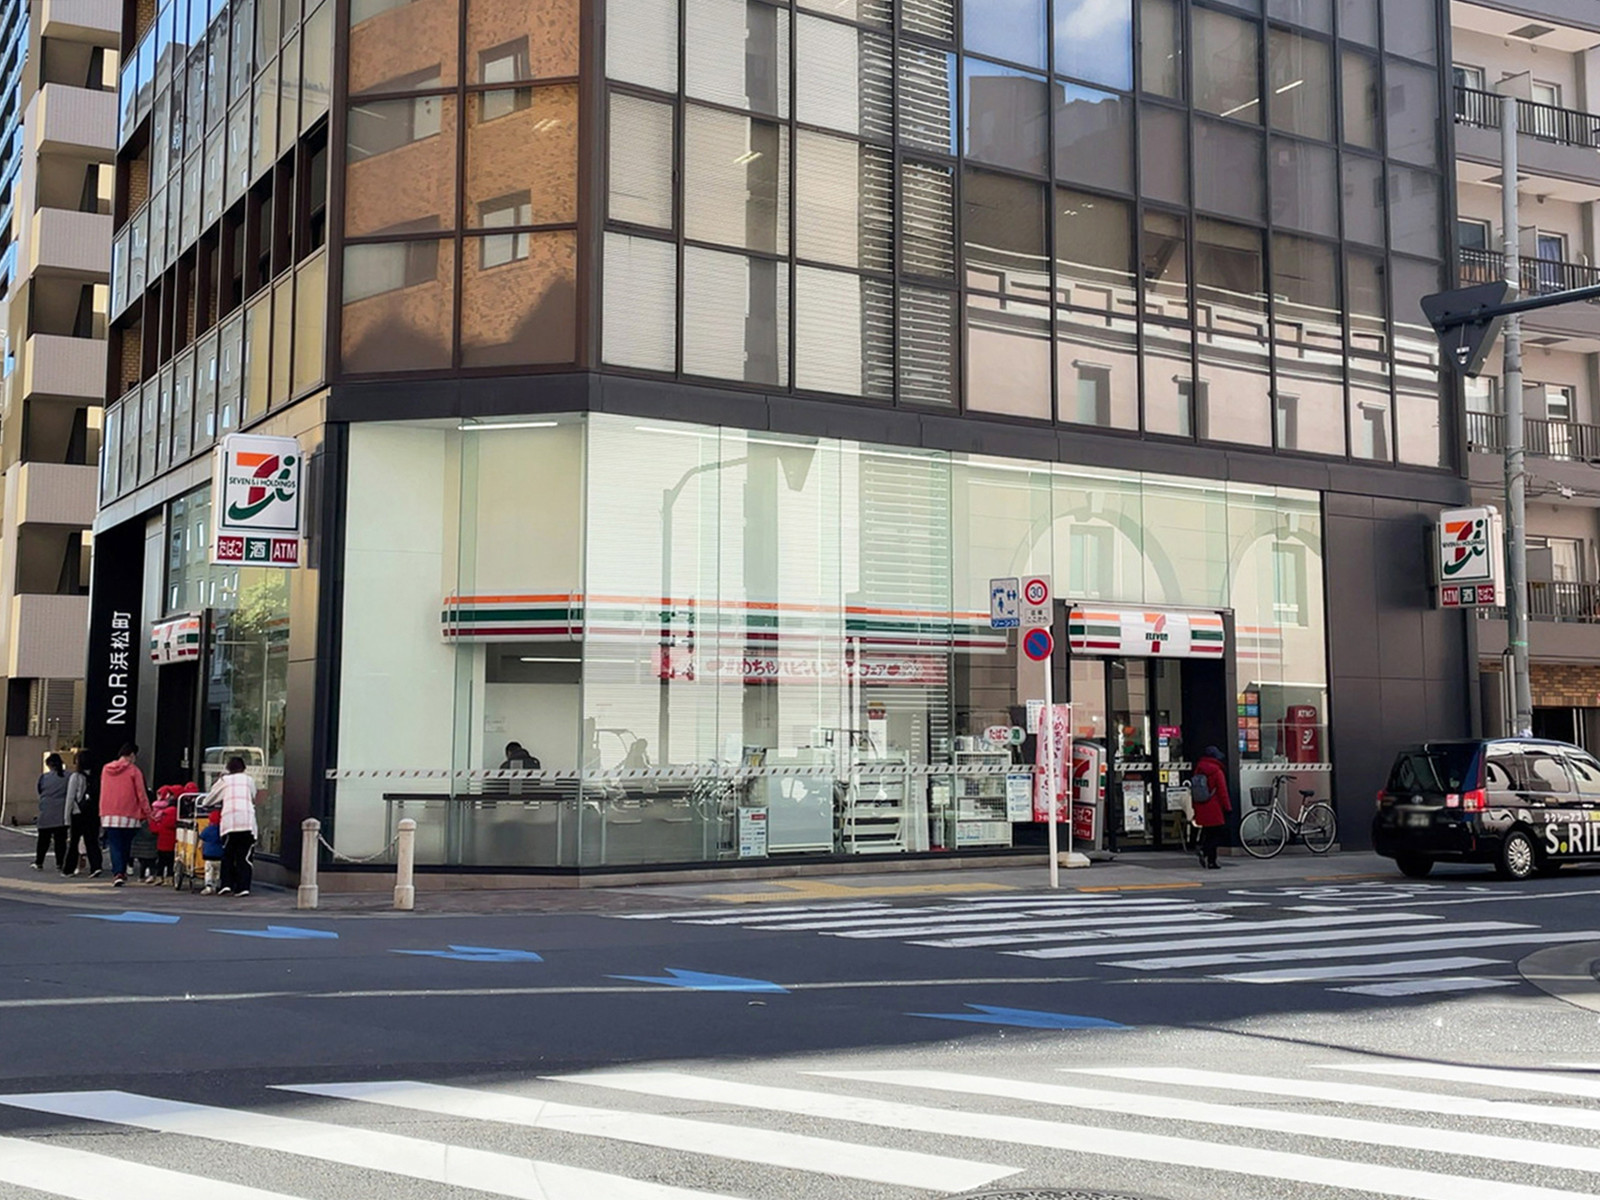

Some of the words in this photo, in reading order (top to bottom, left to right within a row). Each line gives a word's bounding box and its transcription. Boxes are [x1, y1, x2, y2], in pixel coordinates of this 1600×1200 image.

[260, 479, 297, 489] HOLDINGS
[218, 540, 243, 557] たばこ
[249, 541, 266, 558] 酒
[273, 542, 297, 559] ATM
[1029, 585, 1044, 599] 30
[988, 728, 1009, 741] たばこ
[1544, 812, 1590, 823] タクシーアプリ
